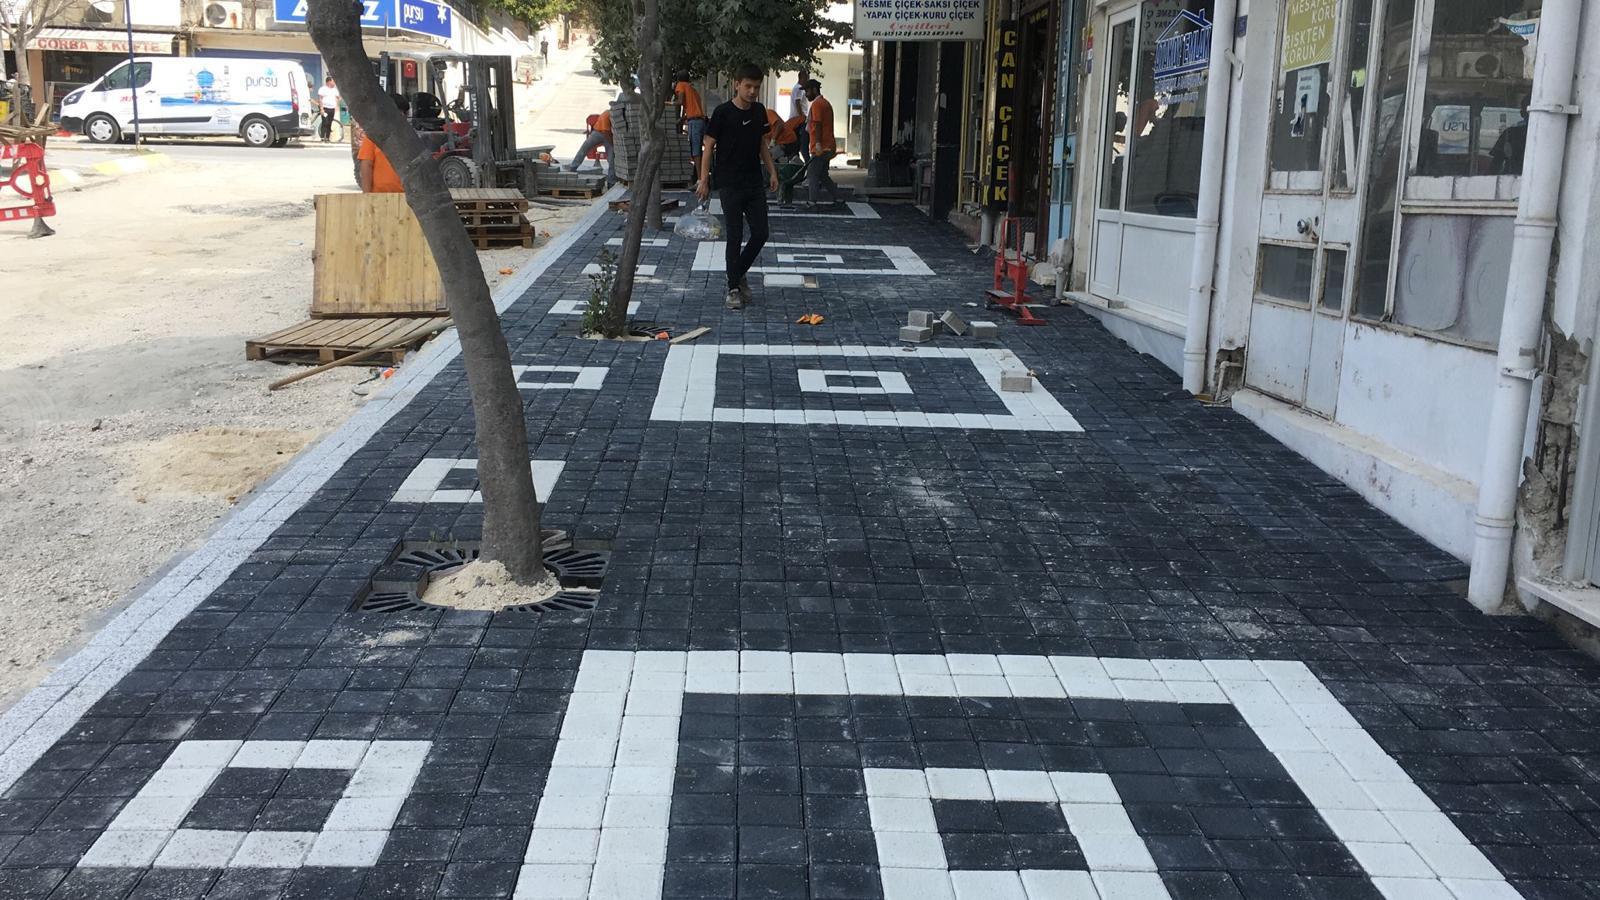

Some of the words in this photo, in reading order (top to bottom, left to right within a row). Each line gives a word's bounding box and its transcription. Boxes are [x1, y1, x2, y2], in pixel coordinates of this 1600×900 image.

[862, 0, 892, 8] KESME
[403, 3, 424, 23] pursu
[866, 11, 892, 19] YAPAY
[894, 10, 920, 21] ÇİÇEK
[922, 11, 947, 19] KURU
[949, 10, 975, 21] ÇİÇEK
[95, 40, 108, 51] &
[1001, 30, 1017, 89] CAN
[245, 76, 278, 91] pursu
[994, 105, 1014, 202] ÇİÇEK
